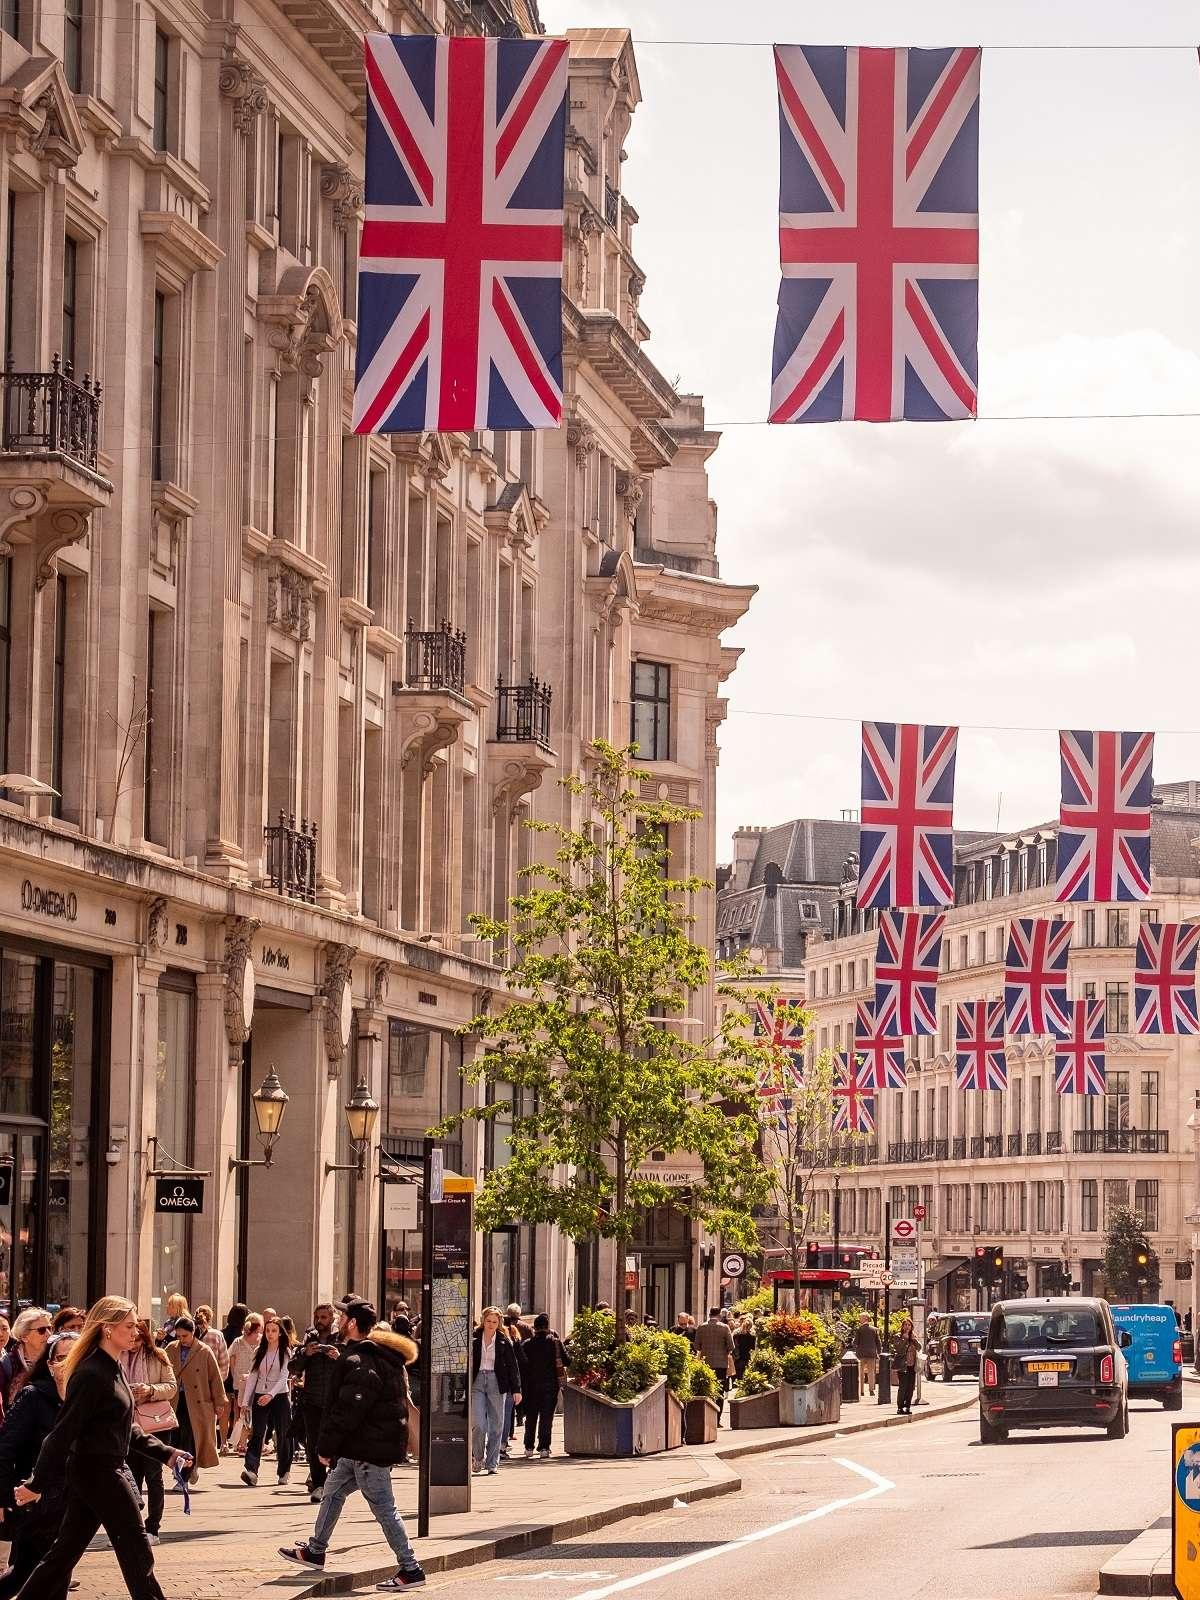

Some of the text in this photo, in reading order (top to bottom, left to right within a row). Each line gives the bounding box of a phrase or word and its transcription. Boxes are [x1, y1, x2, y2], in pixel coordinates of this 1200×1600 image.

[633, 1172, 661, 1183] ANADA
[159, 1197, 199, 1207] OMEGA
[862, 1261, 885, 1269] Piccadi
[1114, 1313, 1167, 1323] aundryheap
